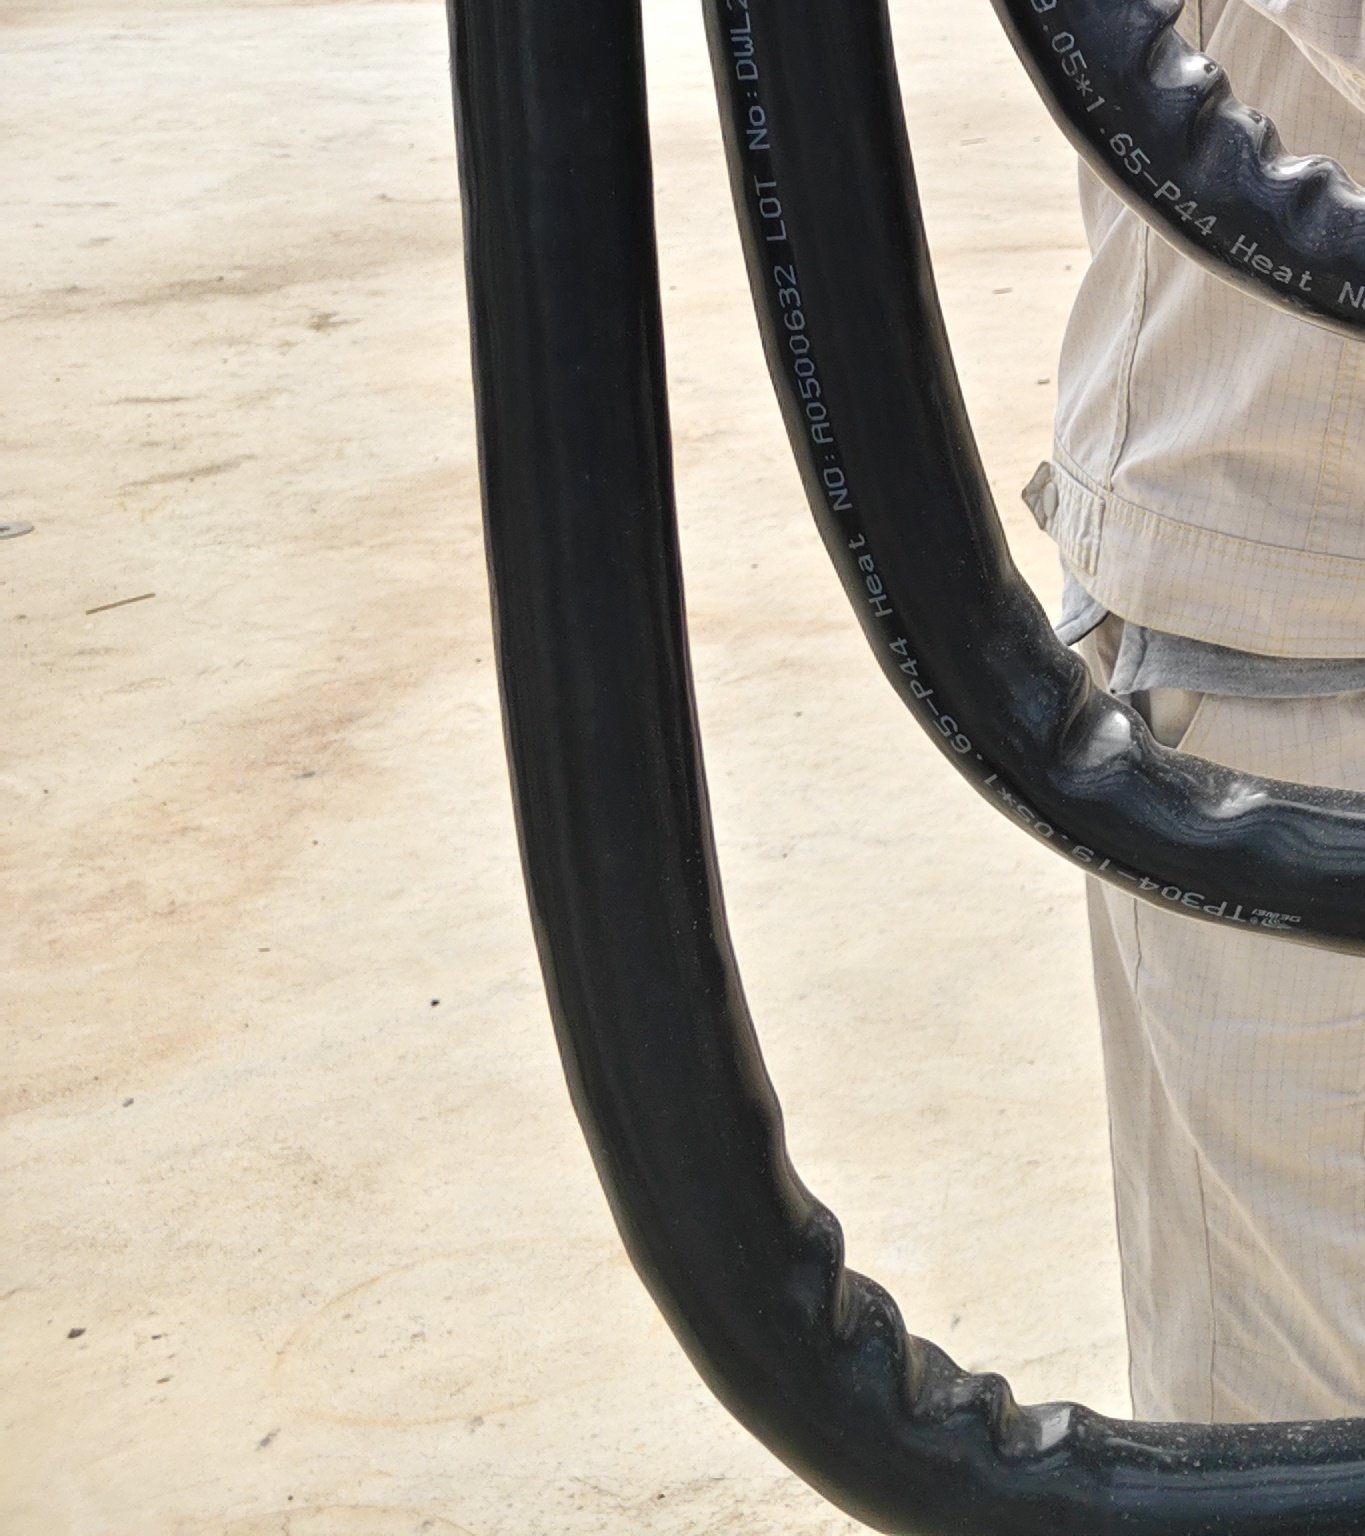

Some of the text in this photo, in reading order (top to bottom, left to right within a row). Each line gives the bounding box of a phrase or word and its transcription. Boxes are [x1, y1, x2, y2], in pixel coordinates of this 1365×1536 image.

[754, 175, 787, 241] LOT
[1229, 234, 1313, 292] Heat
[848, 533, 893, 618] Heat
